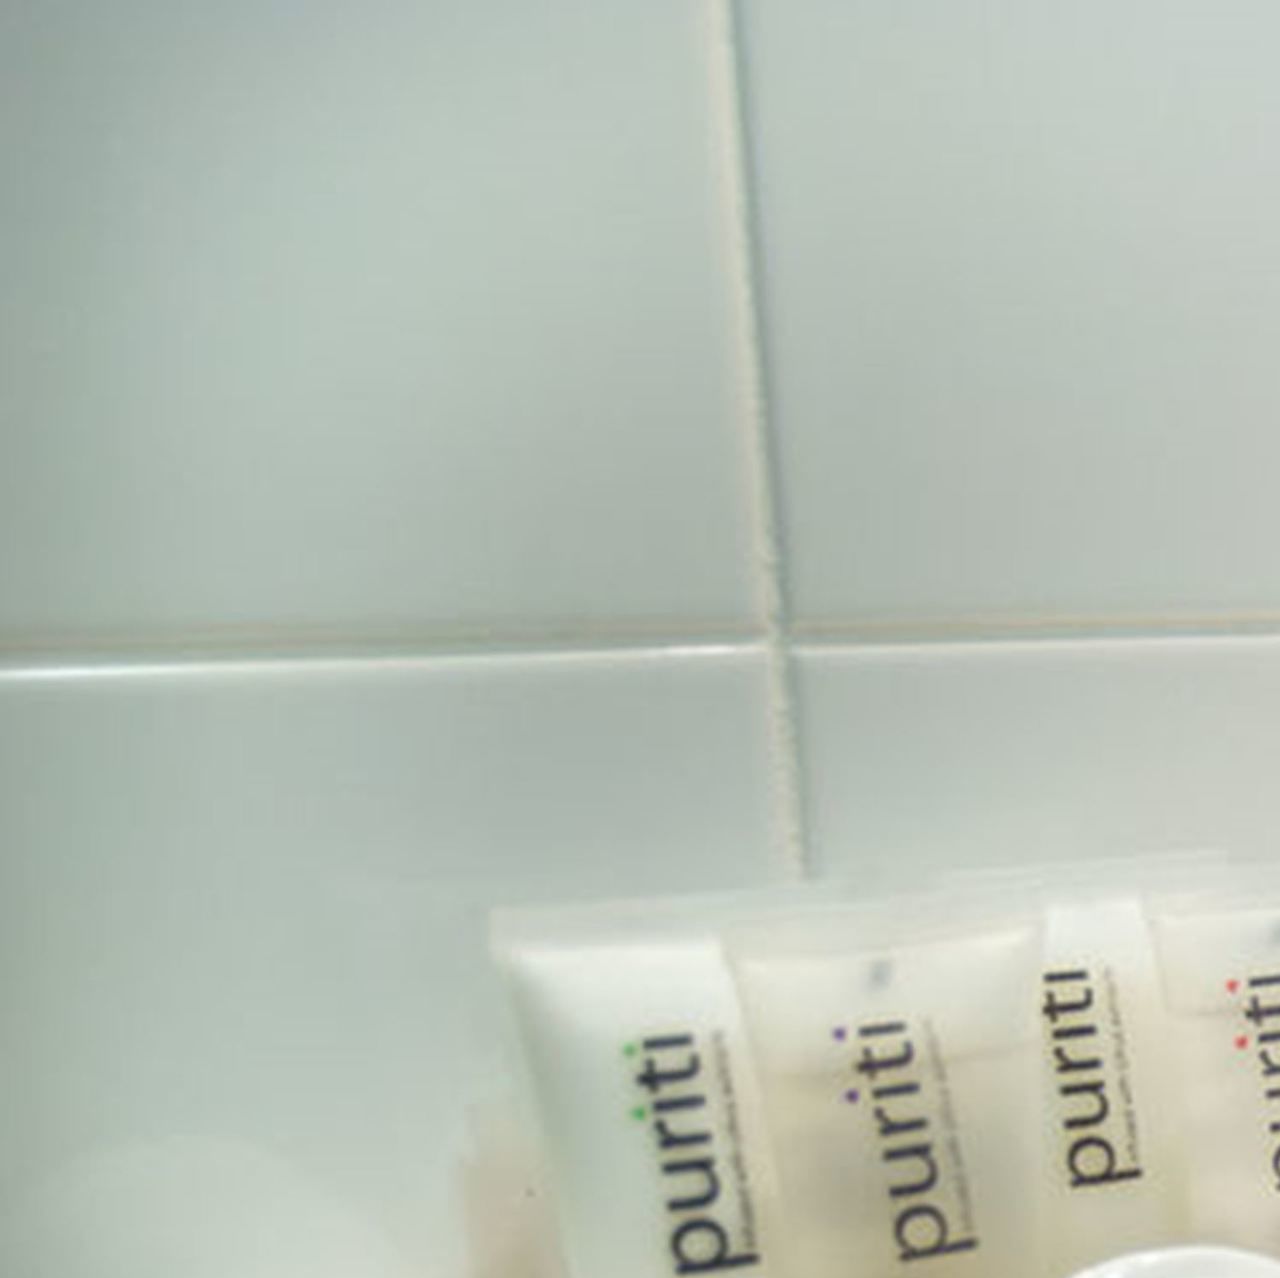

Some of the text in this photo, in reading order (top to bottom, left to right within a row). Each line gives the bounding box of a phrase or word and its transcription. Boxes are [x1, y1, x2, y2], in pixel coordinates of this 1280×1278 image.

[622, 1032, 760, 1276] puriti
[832, 1020, 979, 1262] puriti
[1040, 967, 1143, 1190] puriti
